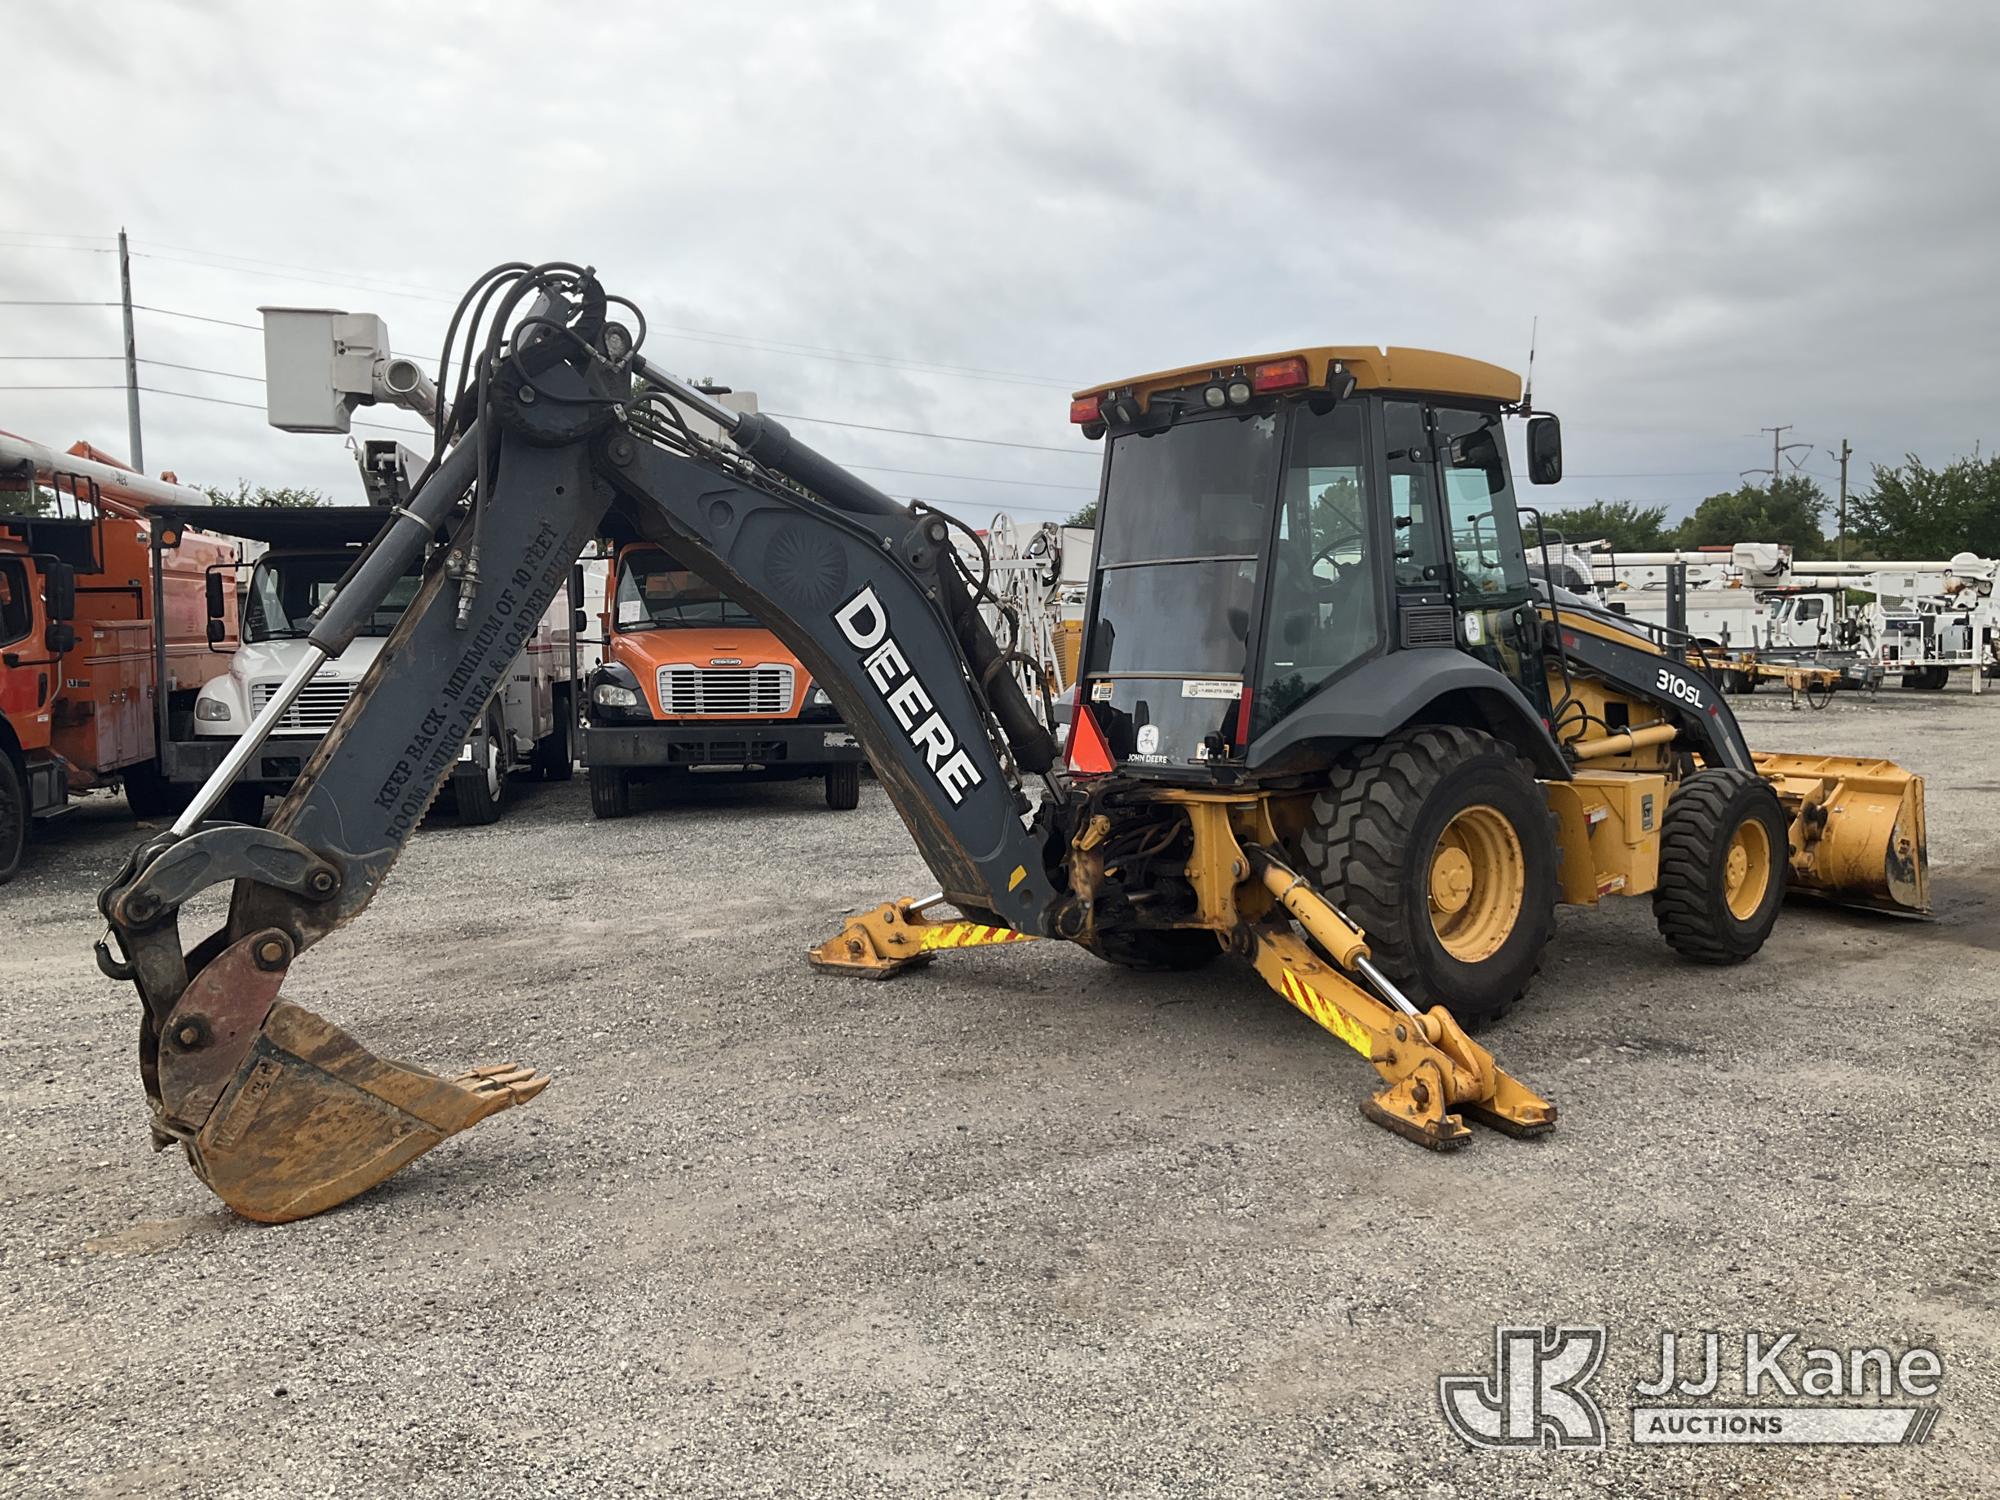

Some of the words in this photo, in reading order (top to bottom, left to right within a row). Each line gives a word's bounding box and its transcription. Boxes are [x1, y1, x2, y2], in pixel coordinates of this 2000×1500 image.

[521, 521, 560, 571] FEET
[493, 587, 520, 618] OF
[510, 567, 533, 590] 10
[384, 783, 429, 844] BOOM
[457, 671, 498, 725] AREA
[497, 585, 550, 659] LOADER
[540, 522, 588, 589] BUCKE
[442, 613, 504, 701] MINIMUM
[834, 586, 982, 805] DEERE
[1656, 668, 1703, 709] 310SL
[404, 706, 447, 762] BACK
[1127, 753, 1145, 762] JOHN
[1145, 754, 1168, 764] DEERE
[374, 758, 415, 812] KEEP
